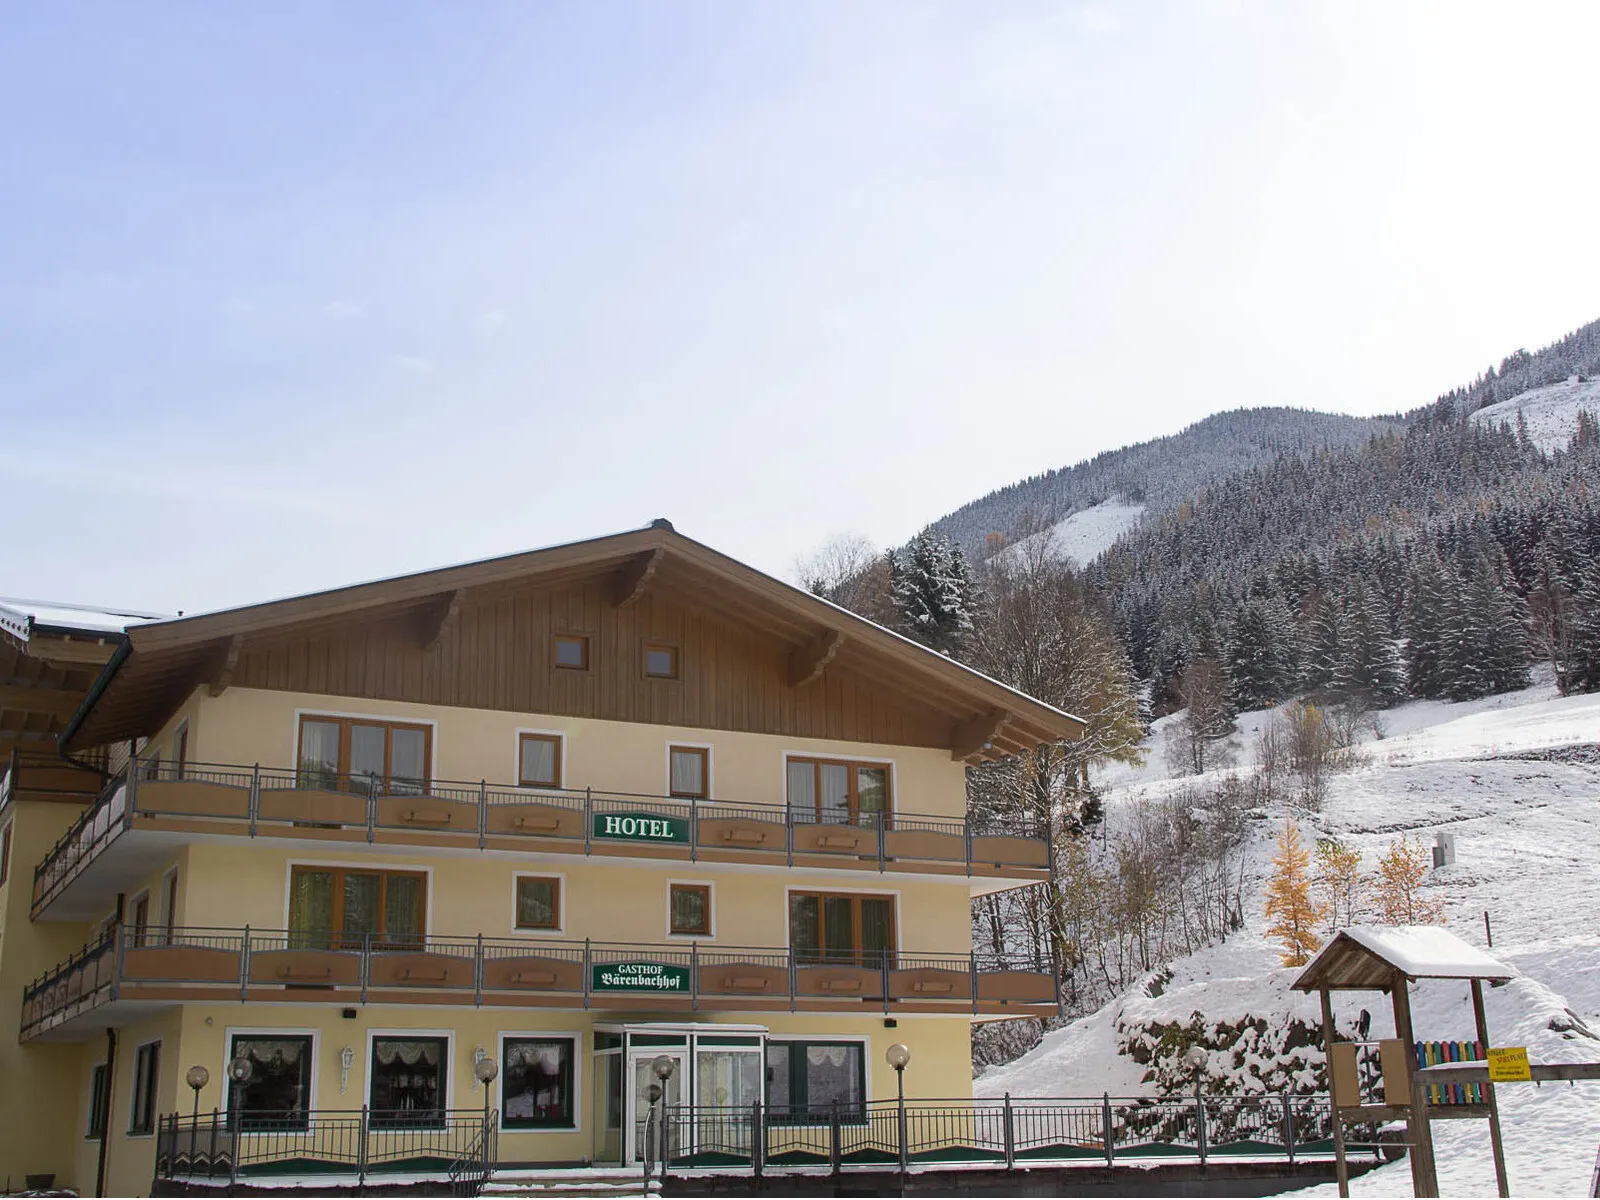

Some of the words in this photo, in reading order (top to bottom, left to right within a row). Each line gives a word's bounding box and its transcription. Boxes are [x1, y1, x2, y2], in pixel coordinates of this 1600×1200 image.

[605, 816, 673, 837] HOTEL
[618, 964, 663, 974] GASTHOF
[601, 973, 680, 989] Bärenbachhof
